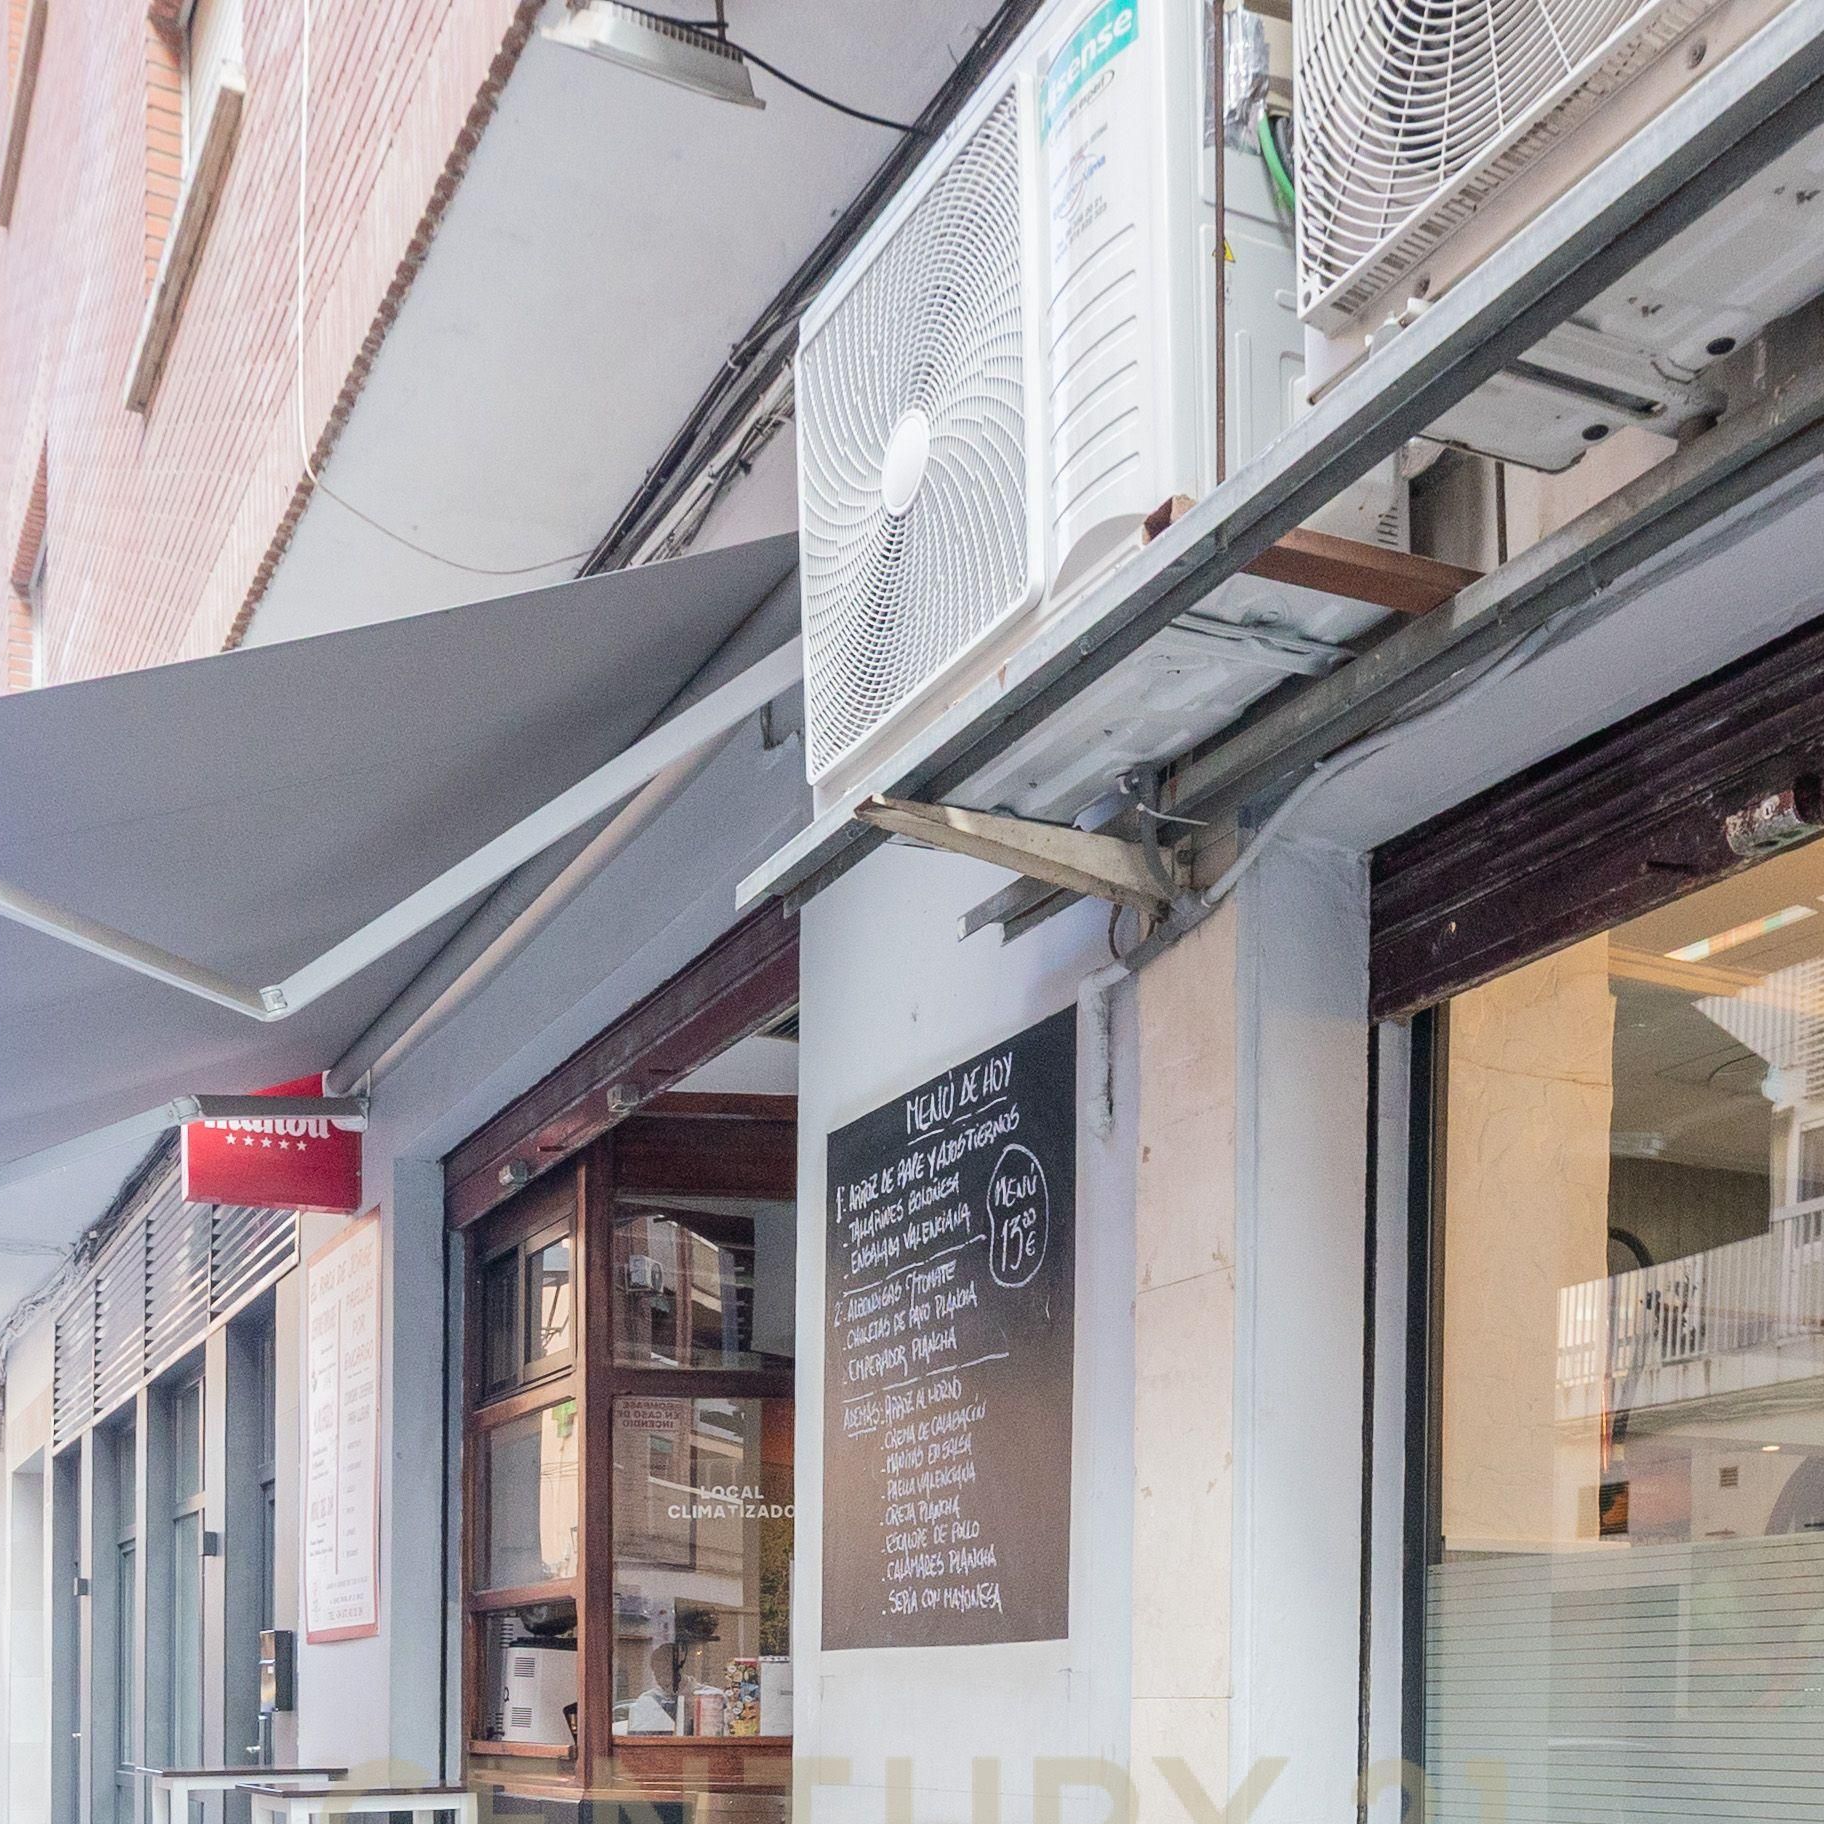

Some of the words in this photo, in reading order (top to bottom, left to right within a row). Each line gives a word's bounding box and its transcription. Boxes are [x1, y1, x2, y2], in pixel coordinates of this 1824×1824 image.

[906, 1070, 955, 1134] MENÚ
[959, 1065, 982, 1106] DE
[982, 1051, 1013, 1095] HOY
[849, 1173, 879, 1211] ARROZ
[881, 1168, 895, 1194] DE
[927, 1147, 936, 1178] Y
[994, 1163, 1038, 1208] MENÚ
[893, 1310, 906, 1337] DE
[700, 1485, 764, 1500] LOCAL
[933, 1523, 948, 1545] DE
[951, 1520, 980, 1543] POLLO
[921, 1587, 941, 1610] CON
